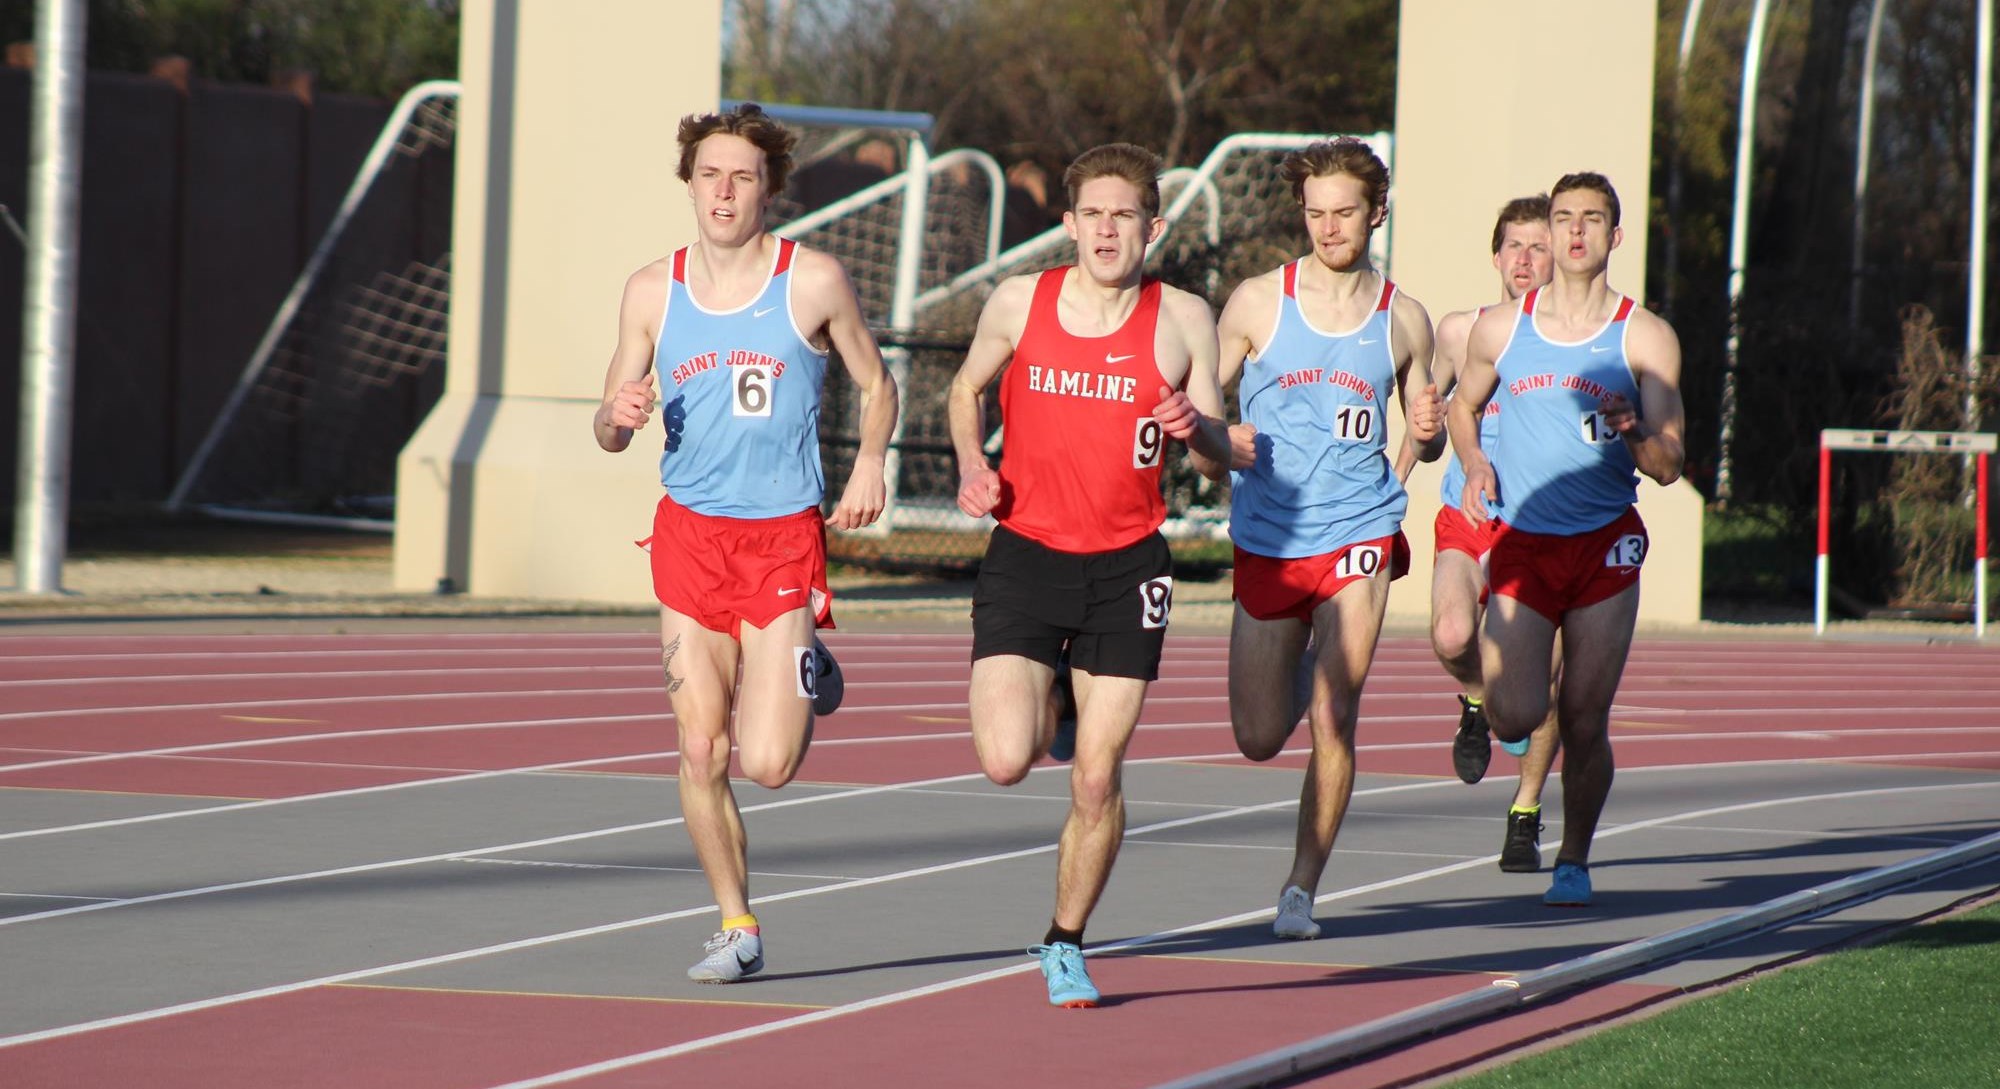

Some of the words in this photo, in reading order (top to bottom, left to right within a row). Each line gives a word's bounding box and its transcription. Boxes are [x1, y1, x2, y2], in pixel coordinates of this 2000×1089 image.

[672, 351, 718, 386] SAINT
[726, 350, 786, 379] JOHN'S
[1028, 365, 1137, 403] HAMLINE
[1278, 368, 1324, 390] SAINT
[1328, 369, 1377, 402] JOHN'S
[738, 368, 767, 413] 6
[1509, 373, 1556, 397] SAINT
[1561, 374, 1613, 403] JOHN'S
[1337, 407, 1371, 439] 10
[1138, 420, 1161, 465] 9
[1340, 549, 1378, 575] 10
[1613, 538, 1643, 565] 13
[1145, 581, 1168, 624] 9
[800, 650, 815, 696] 6
